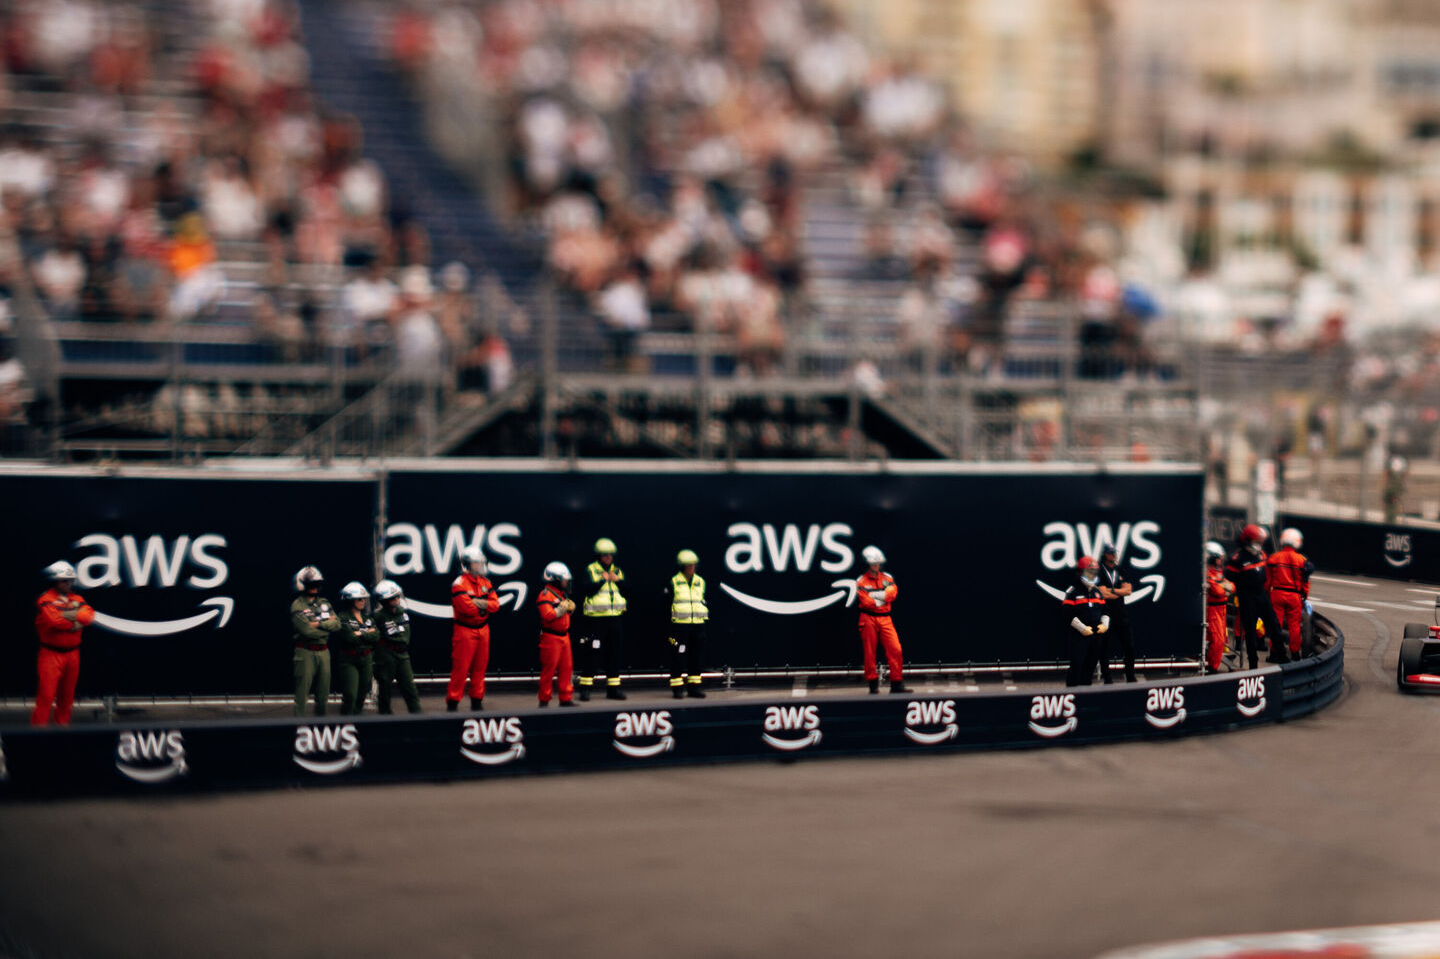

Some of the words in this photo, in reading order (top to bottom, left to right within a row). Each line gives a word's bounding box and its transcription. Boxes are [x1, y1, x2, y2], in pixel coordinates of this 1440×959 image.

[384, 523, 522, 575] aws
[725, 523, 853, 572] aws
[1042, 521, 1161, 569] aws
[1386, 534, 1411, 552] aws
[76, 534, 228, 588] aws
[1146, 687, 1185, 713] aws
[1237, 676, 1265, 700] aws
[765, 705, 820, 731] aws
[905, 700, 957, 727] aws
[1030, 694, 1077, 720] aws
[295, 724, 358, 752] aws
[462, 717, 522, 745] aws
[615, 710, 673, 738] aws
[118, 731, 184, 760] aws
